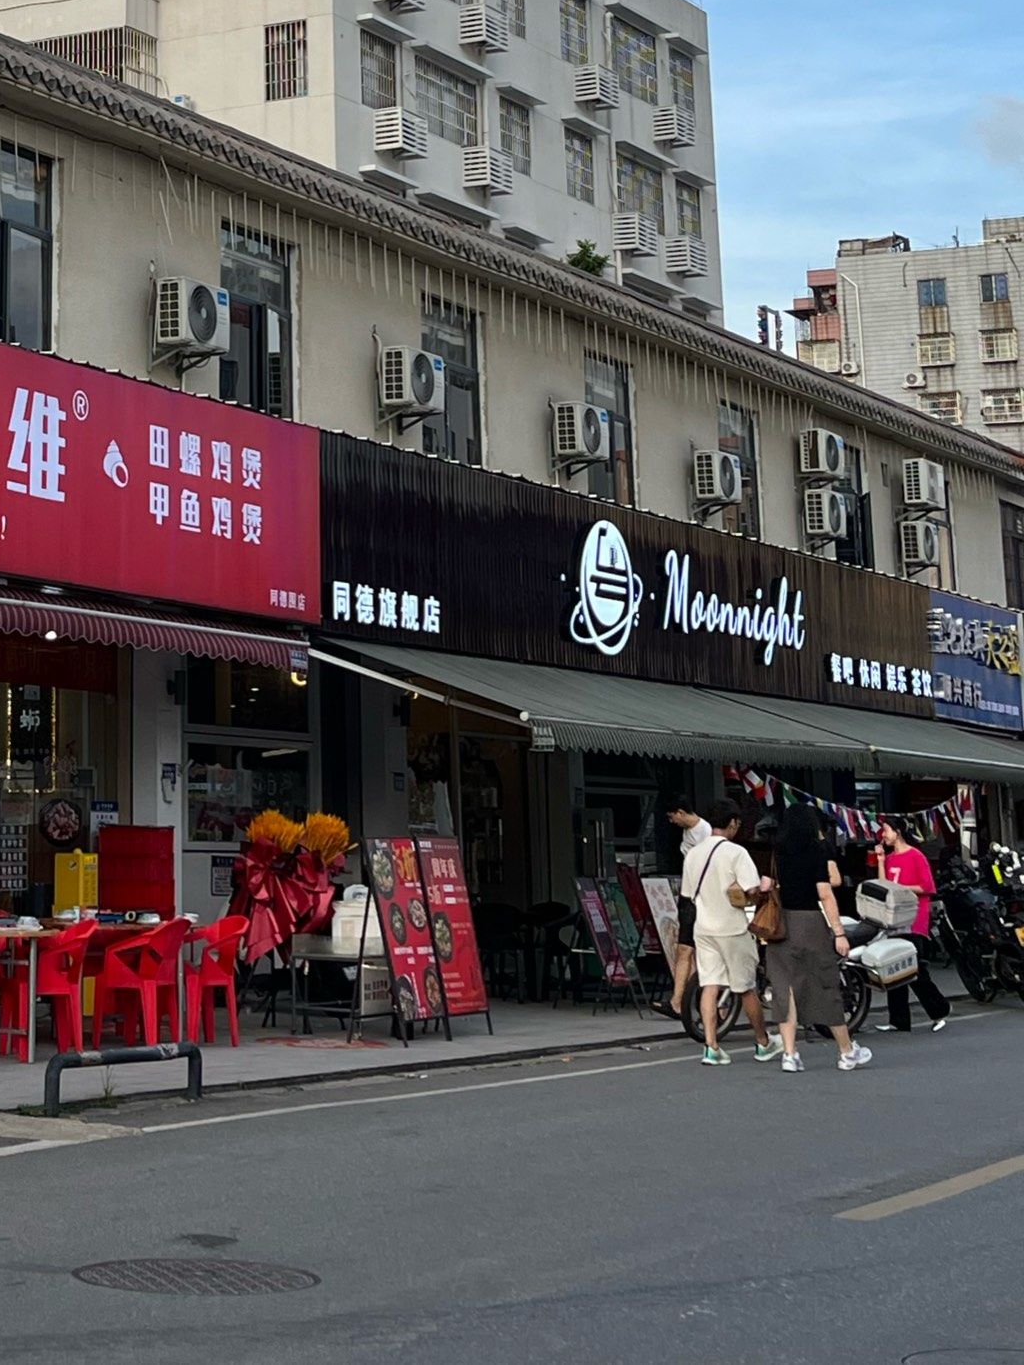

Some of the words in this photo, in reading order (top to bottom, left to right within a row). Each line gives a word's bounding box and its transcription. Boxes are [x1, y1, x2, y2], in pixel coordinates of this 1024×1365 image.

[149, 424, 262, 490] 田螺鸡煲
[149, 481, 262, 545] 甲鱼鸡煲
[332, 580, 441, 634] 同德旗舰店
[663, 548, 806, 667] Moonnight
